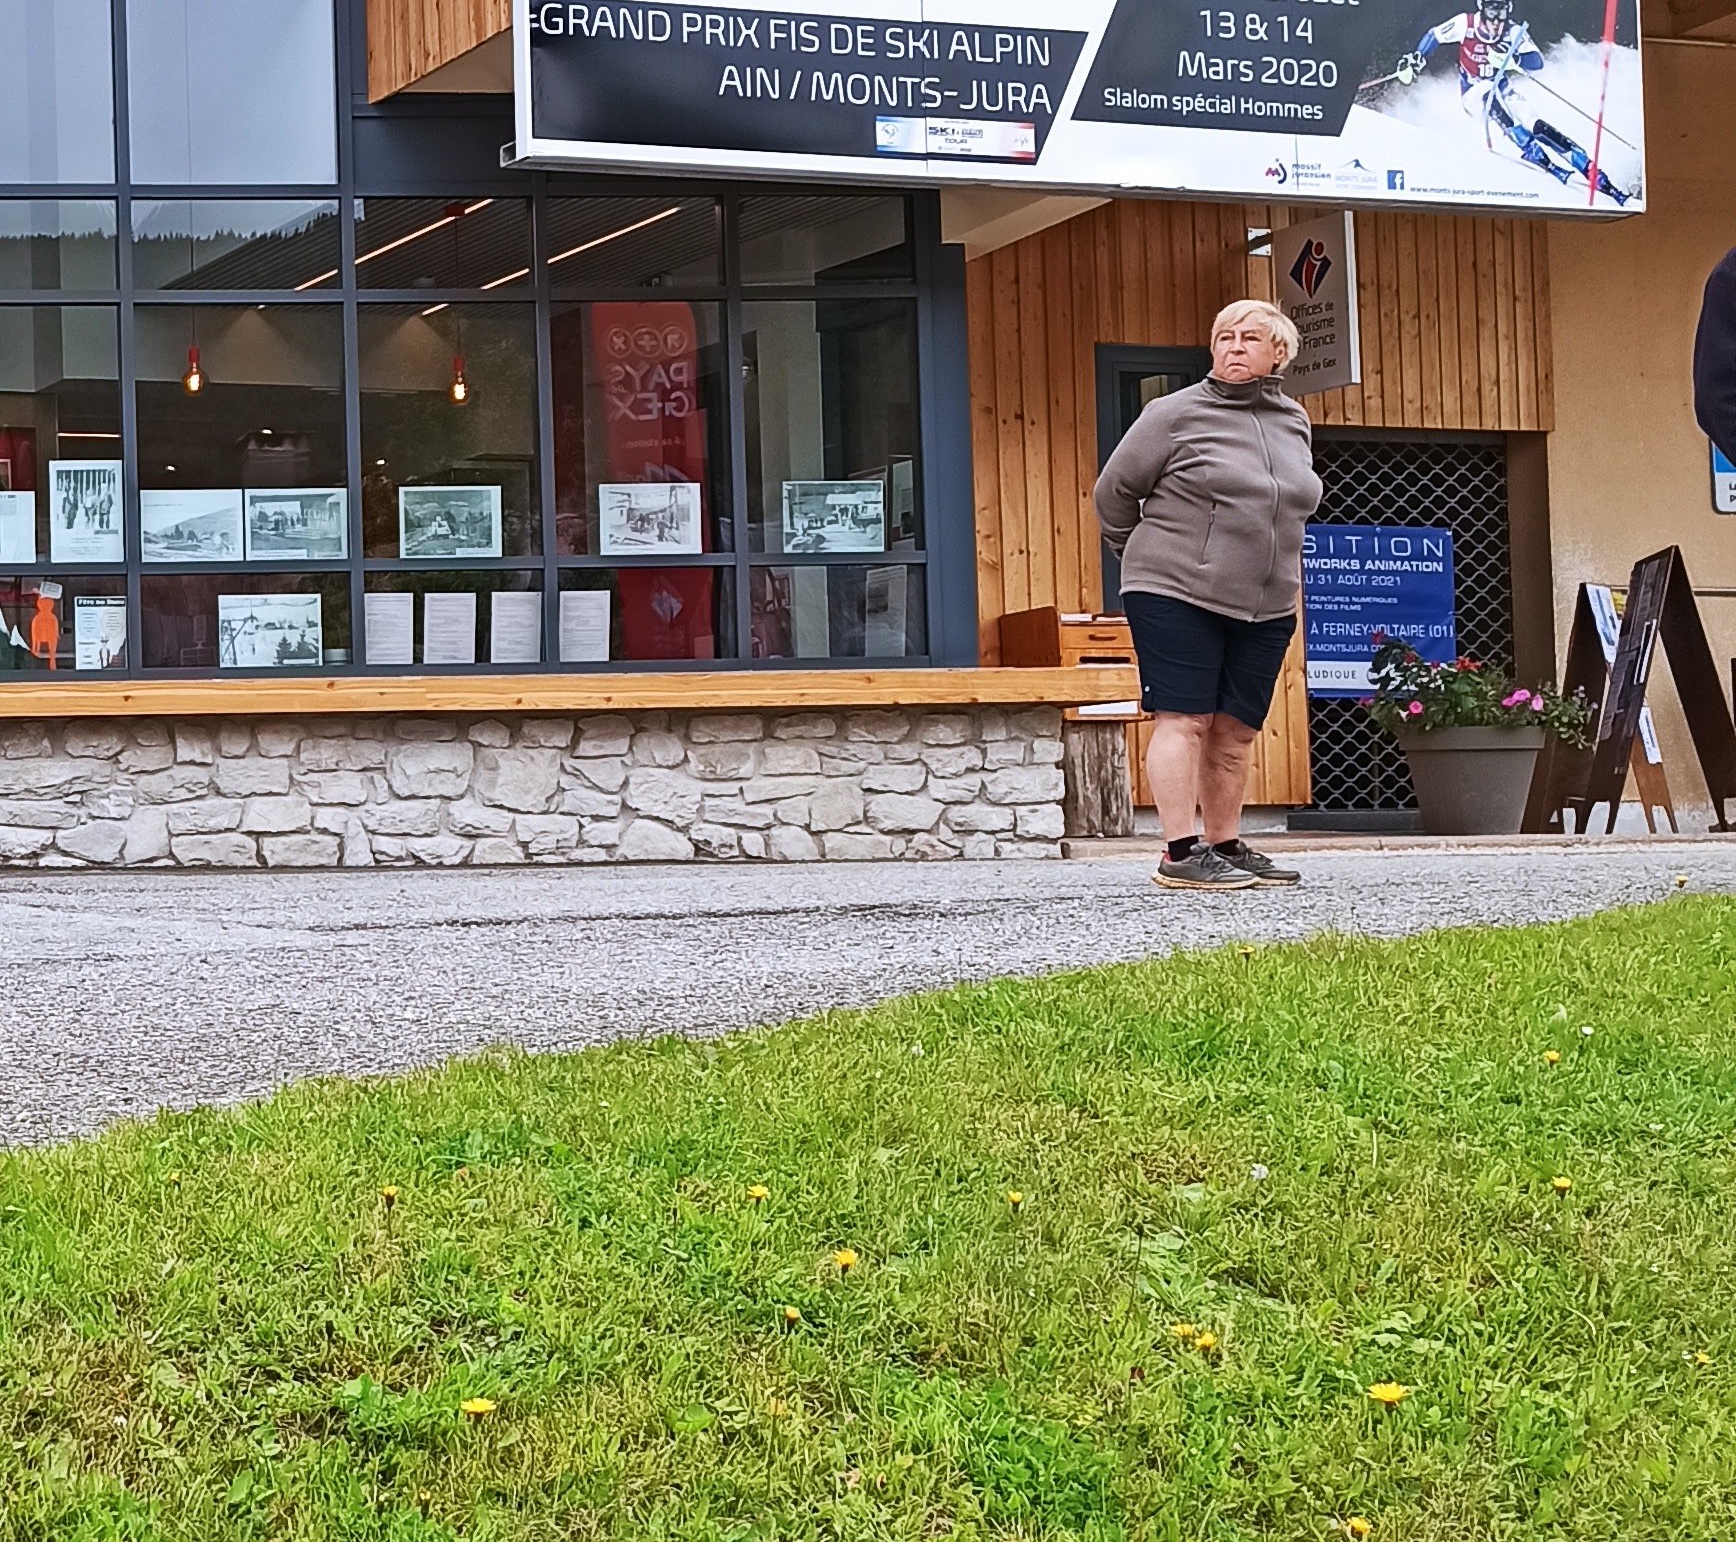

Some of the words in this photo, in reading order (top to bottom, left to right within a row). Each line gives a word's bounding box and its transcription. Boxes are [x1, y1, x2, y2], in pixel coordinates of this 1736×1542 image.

[539, 3, 672, 43] GRAND
[682, 11, 761, 49] PRIX
[769, 18, 820, 53] FIS
[830, 22, 877, 57] DE
[885, 26, 941, 60] SKI
[949, 28, 1051, 67] ALPIN
[1199, 10, 1236, 39] 13
[1245, 13, 1268, 42] &
[1277, 15, 1314, 44] 14
[1178, 50, 1254, 82] Mars
[1261, 56, 1338, 88] 2020
[719, 65, 780, 99] AIN
[790, 71, 802, 101] /
[811, 70, 1053, 116] MONTS-JURA
[1103, 87, 1168, 110] Slalom
[1172, 93, 1236, 116] spécial
[1240, 97, 1324, 120] Hommes
[1291, 302, 1323, 320] Offices
[1324, 301, 1334, 312] de
[1303, 333, 1336, 351] France
[1292, 364, 1310, 376] Pays
[1311, 360, 1321, 372] de
[1322, 358, 1337, 369] Gex
[1364, 560, 1444, 573] ANIMATION
[1317, 574, 1332, 585] 31
[1337, 573, 1368, 586] AOÛT
[1371, 576, 1402, 587] 2021
[1310, 595, 1350, 603] PEINTURES
[1310, 620, 1319, 635] À
[1323, 622, 1426, 638] FERNEY-VOLTAIRE
[1429, 624, 1454, 638] (01)
[1308, 670, 1357, 680] LUDIQUE
